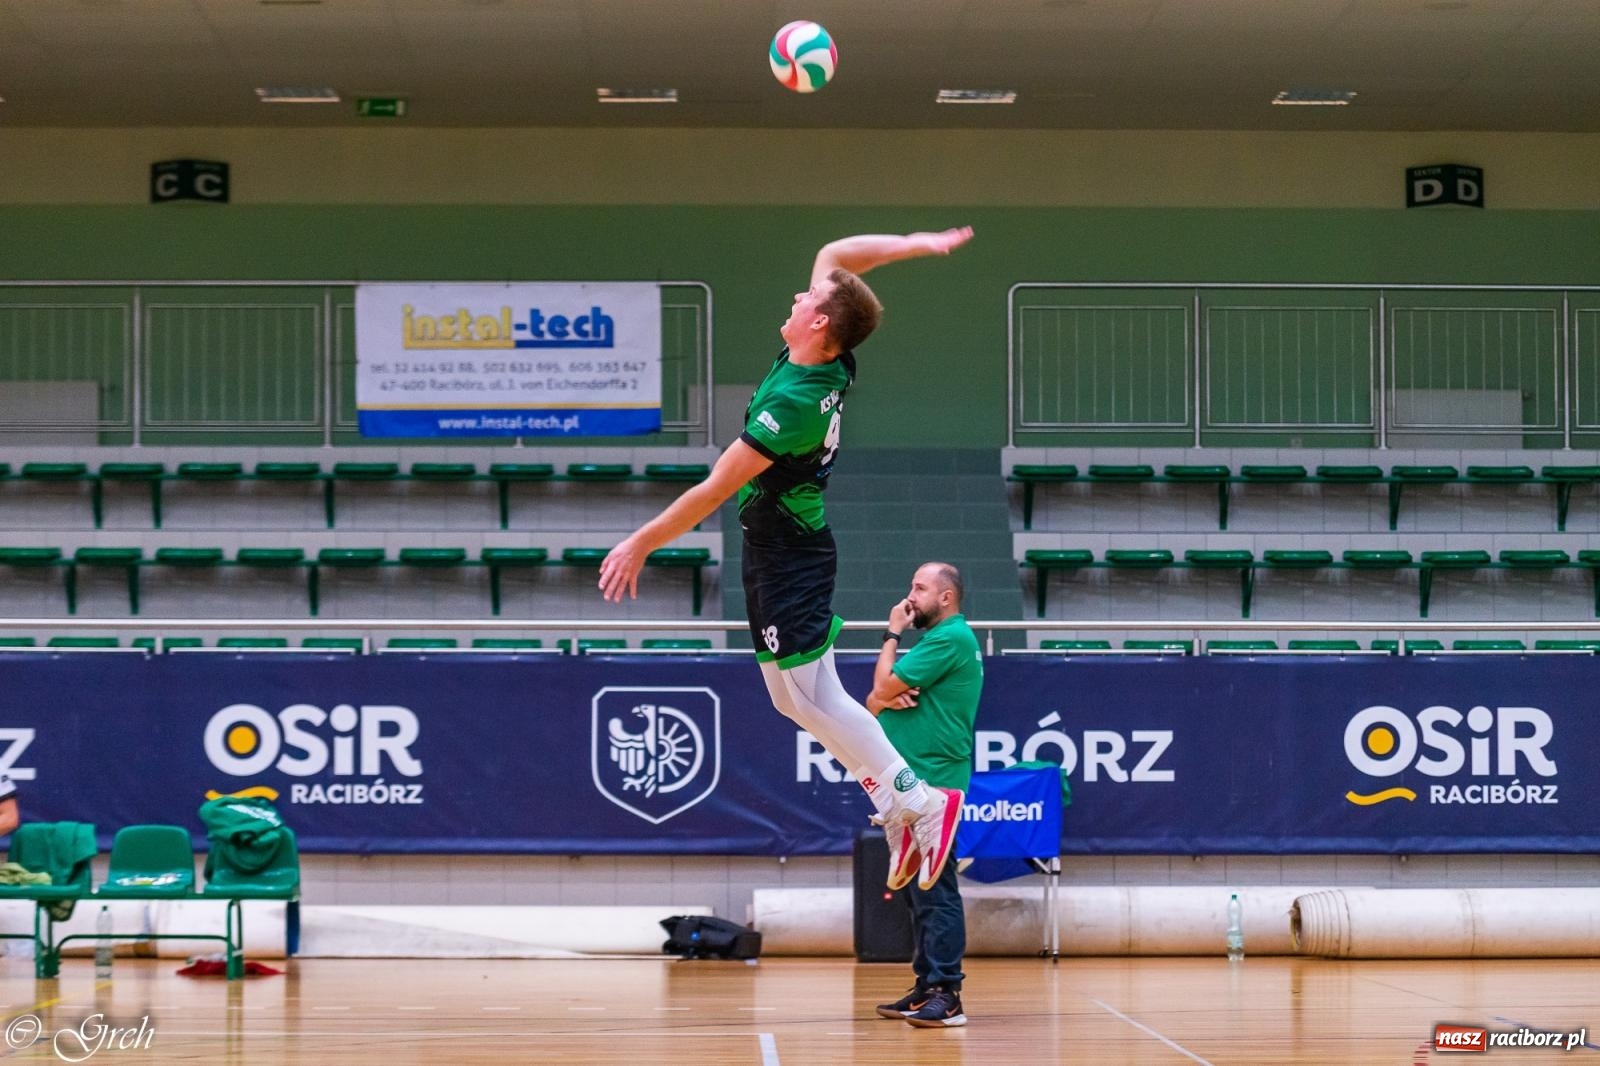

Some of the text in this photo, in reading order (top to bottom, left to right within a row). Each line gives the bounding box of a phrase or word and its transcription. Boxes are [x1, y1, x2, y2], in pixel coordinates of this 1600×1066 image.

[156, 173, 178, 197] C
[194, 173, 222, 197] C
[1414, 178, 1444, 202] D
[1457, 178, 1479, 201] D
[402, 303, 614, 349] instal-tech
[438, 415, 580, 433] www.instal-tech.pl
[203, 703, 424, 777] OSiR
[1343, 705, 1558, 777] OSiR
[291, 778, 424, 804] RACIBÓRZ
[1429, 778, 1559, 804] RACIBÓRZ
